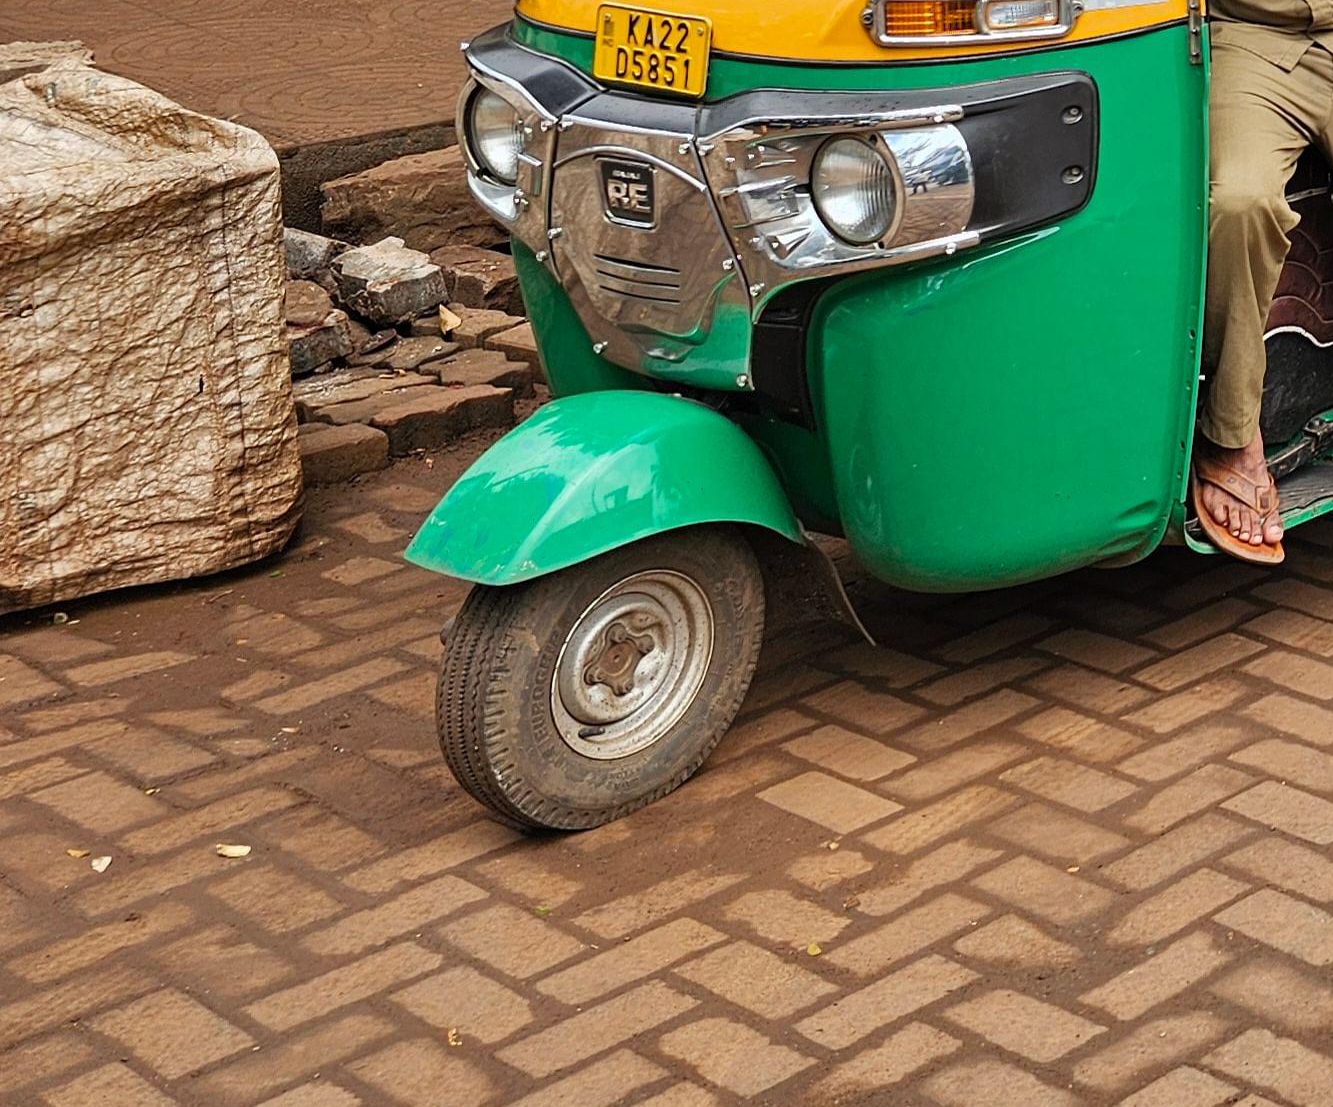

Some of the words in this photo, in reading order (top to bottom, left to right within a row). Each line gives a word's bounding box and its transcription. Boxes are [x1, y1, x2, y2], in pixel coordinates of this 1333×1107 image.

[626, 13, 690, 54] KA22
[615, 47, 691, 90] D5851
[607, 178, 652, 214] RE
